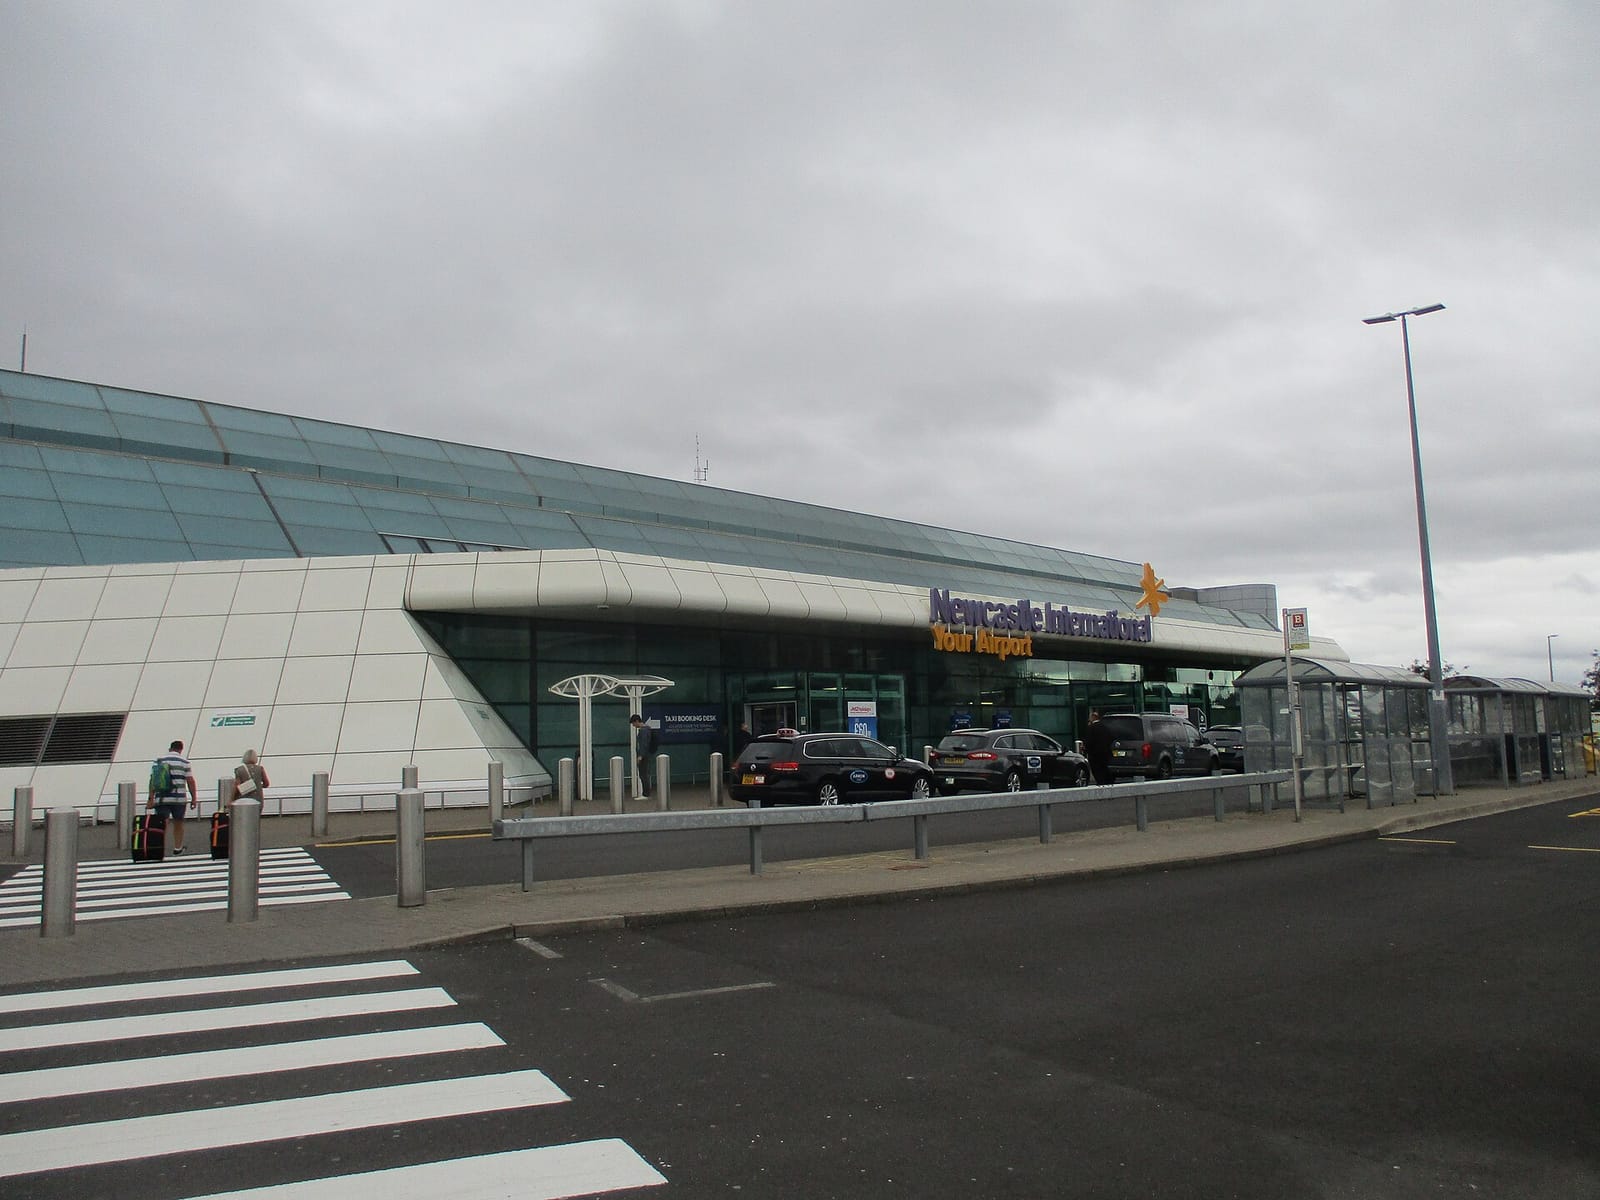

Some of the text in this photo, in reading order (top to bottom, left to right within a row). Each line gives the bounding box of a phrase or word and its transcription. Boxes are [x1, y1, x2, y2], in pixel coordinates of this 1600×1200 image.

[929, 587, 1152, 642] Newcastle International
[1294, 615, 1302, 623] B
[931, 625, 1033, 662] Your Airport
